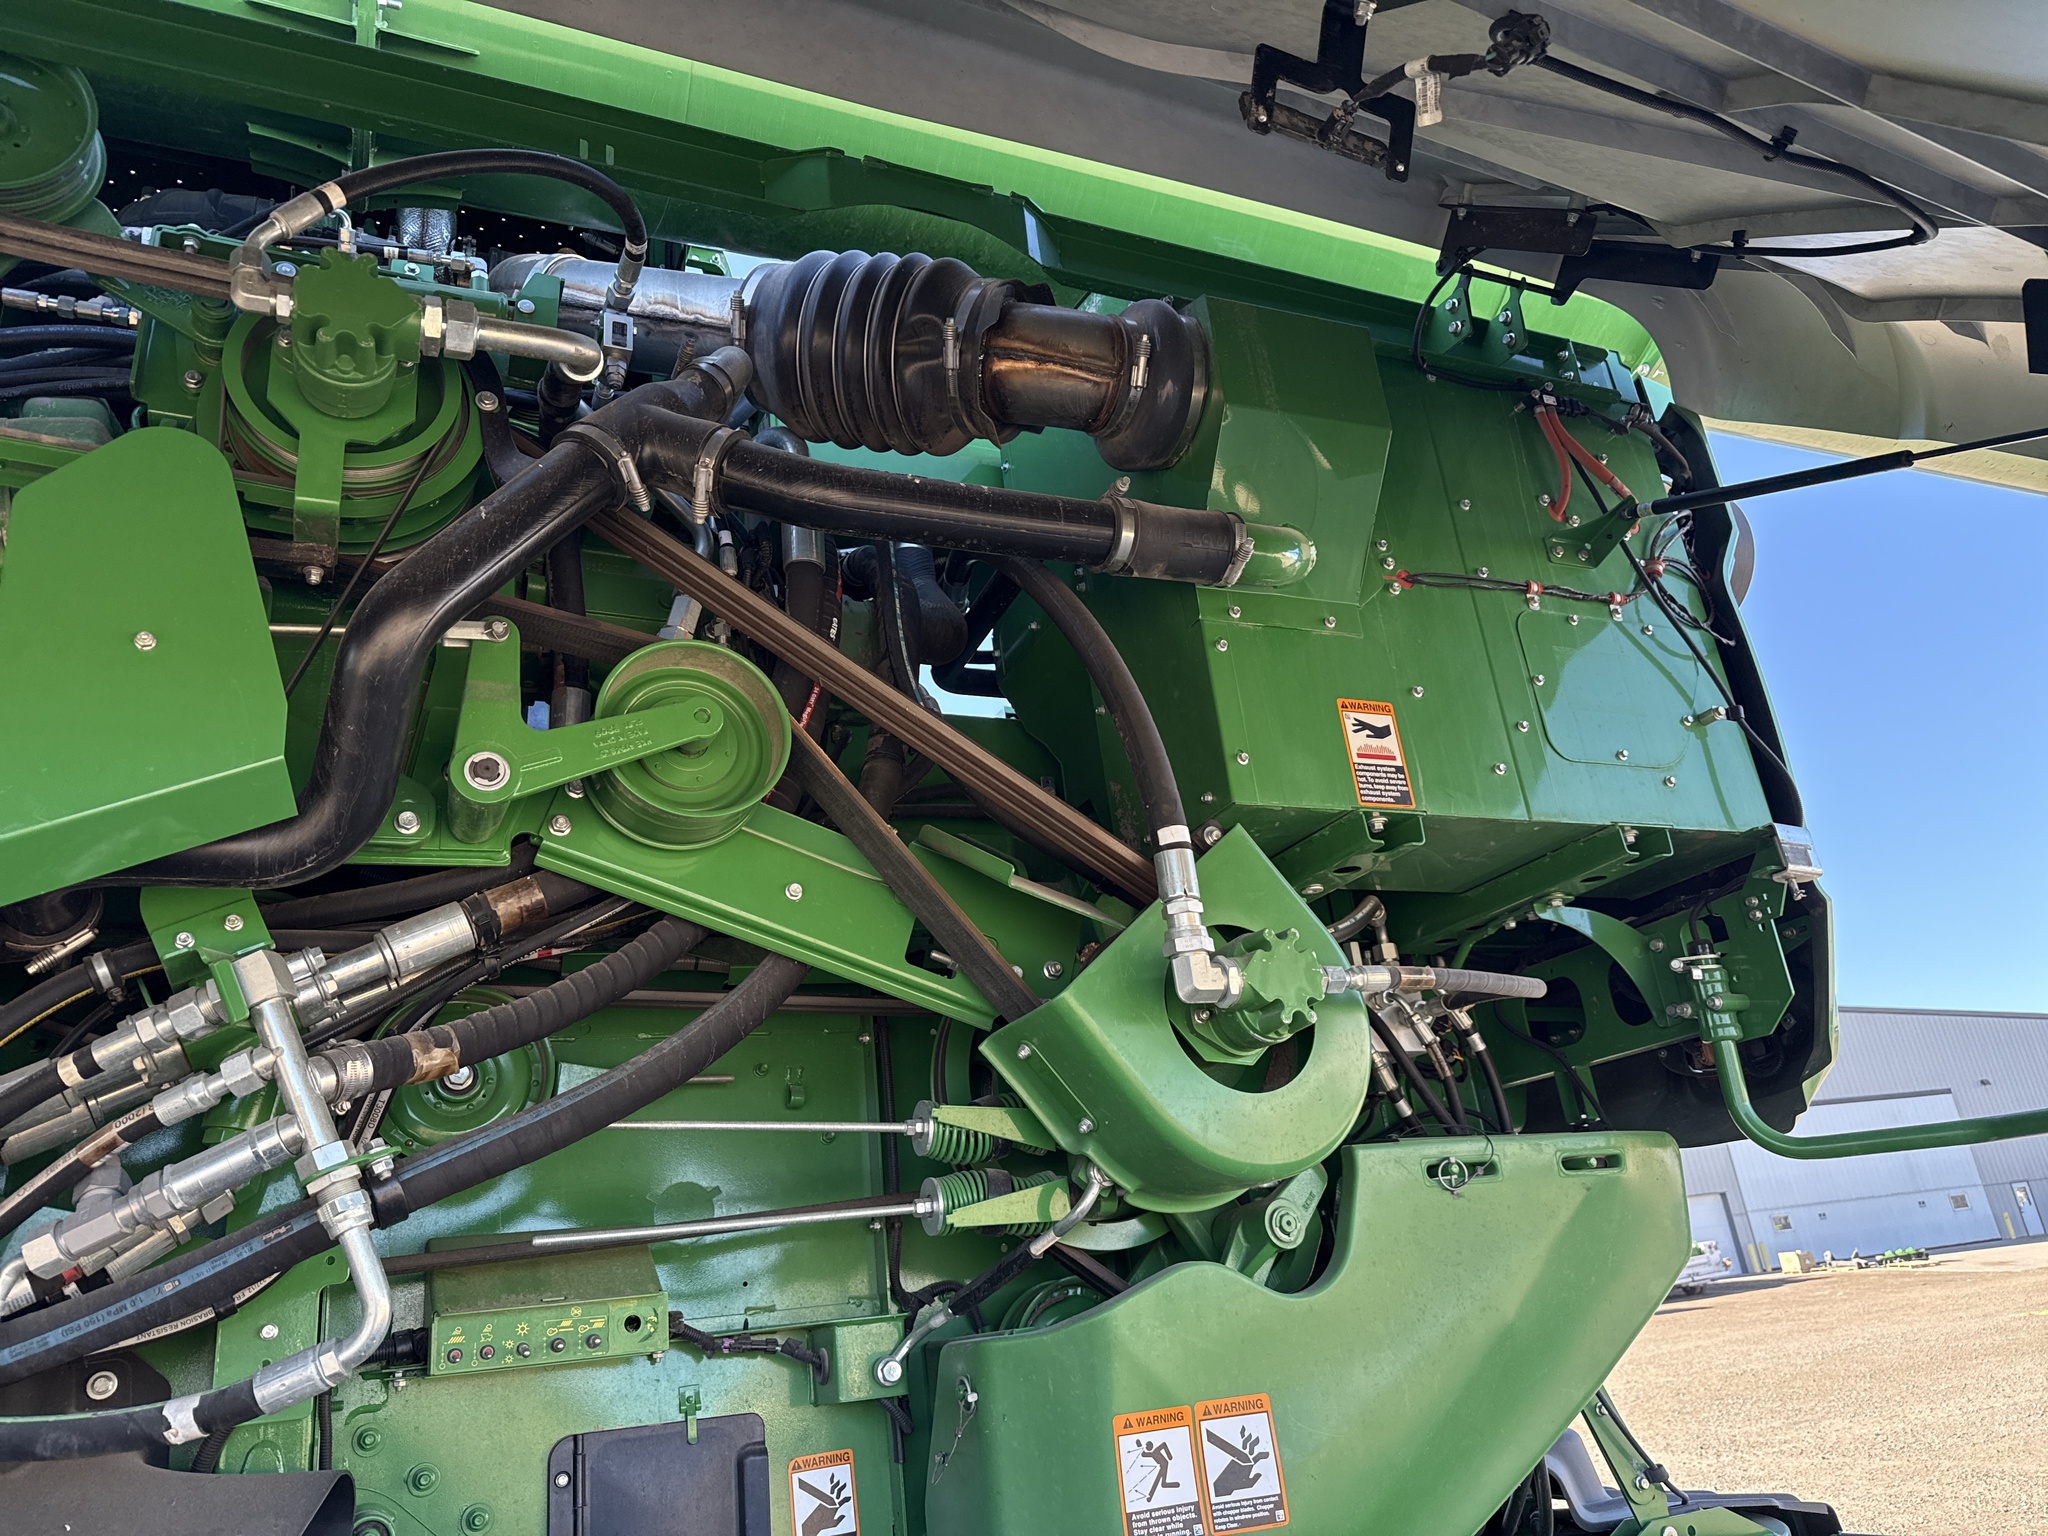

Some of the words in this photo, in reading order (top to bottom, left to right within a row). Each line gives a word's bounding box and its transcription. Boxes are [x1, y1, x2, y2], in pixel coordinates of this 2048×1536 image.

[829, 617, 838, 640] GATES
[1348, 701, 1392, 713] WARNING
[127, 1293, 144, 1308] 1,0
[105, 1302, 128, 1318] MPa
[177, 1307, 216, 1329] BRASION
[82, 1313, 105, 1328] (150
[59, 1322, 82, 1338] PSI)
[133, 1321, 179, 1341] RESISTANT
[1213, 1399, 1264, 1415] WARNING
[1136, 1411, 1185, 1427] WARNING
[802, 1452, 850, 1468] WARNING
[1132, 1511, 1150, 1521] Avoid
[1151, 1508, 1175, 1518] serious
[1176, 1505, 1195, 1513] injury
[1132, 1520, 1148, 1528] from
[1149, 1516, 1171, 1526] thrown
[1172, 1512, 1197, 1522] objects.
[1252, 1511, 1270, 1519] position.
[1133, 1528, 1148, 1536] Stay
[1149, 1525, 1165, 1533] clear
[1166, 1522, 1184, 1530] while
